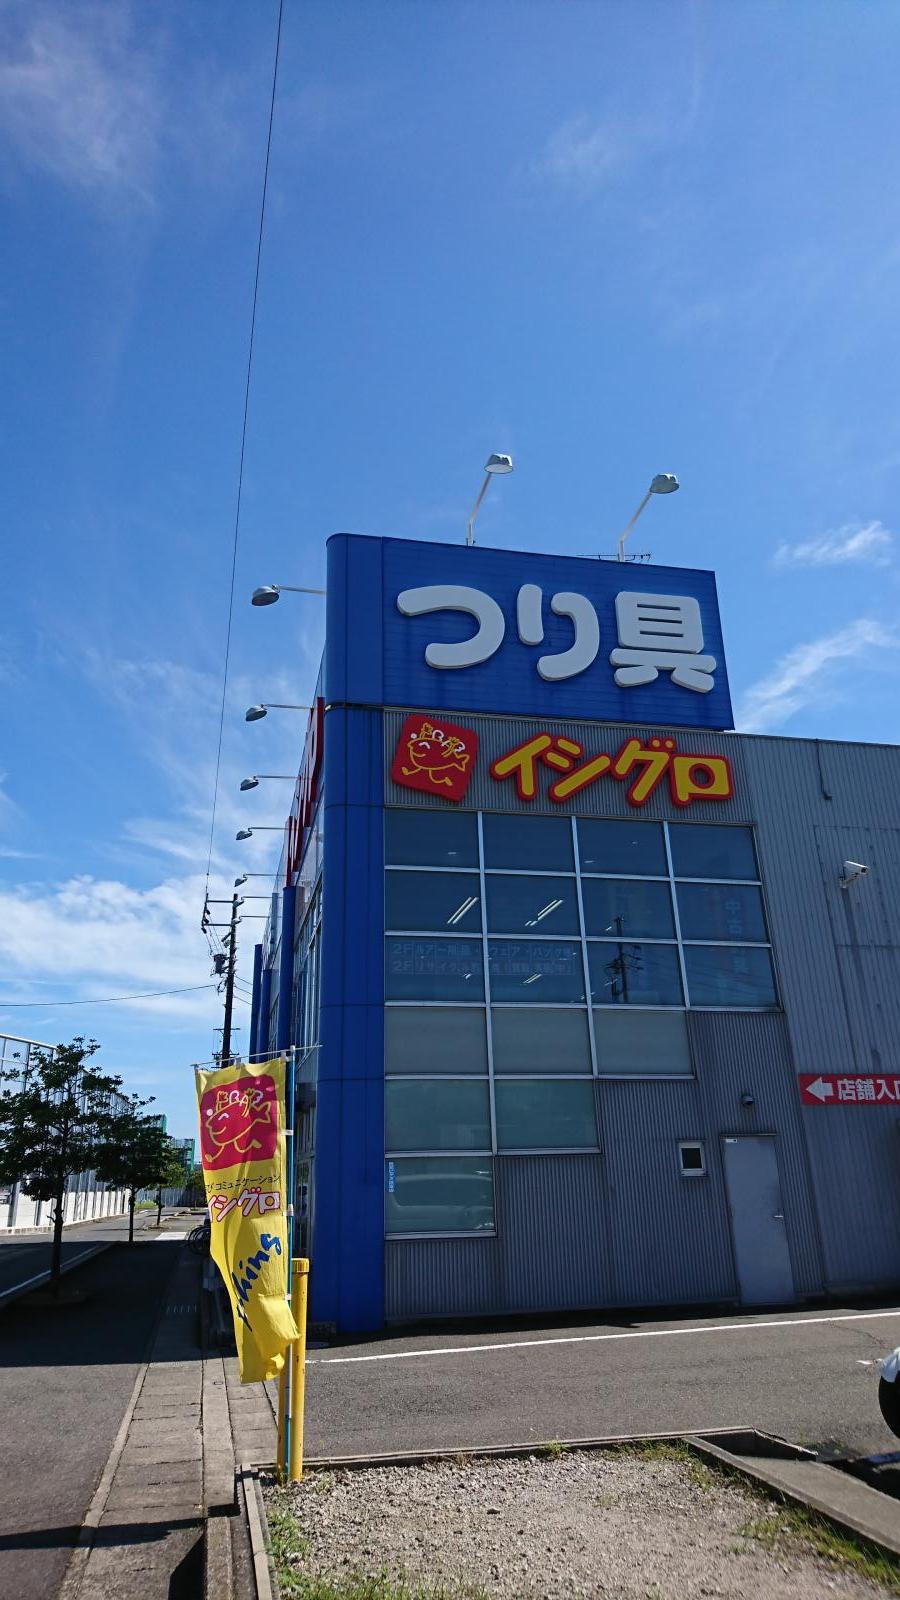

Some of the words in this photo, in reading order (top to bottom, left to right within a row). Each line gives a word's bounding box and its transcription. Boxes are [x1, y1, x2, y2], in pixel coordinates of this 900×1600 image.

[397, 583, 717, 693] つり具
[490, 730, 733, 808] イシグロ
